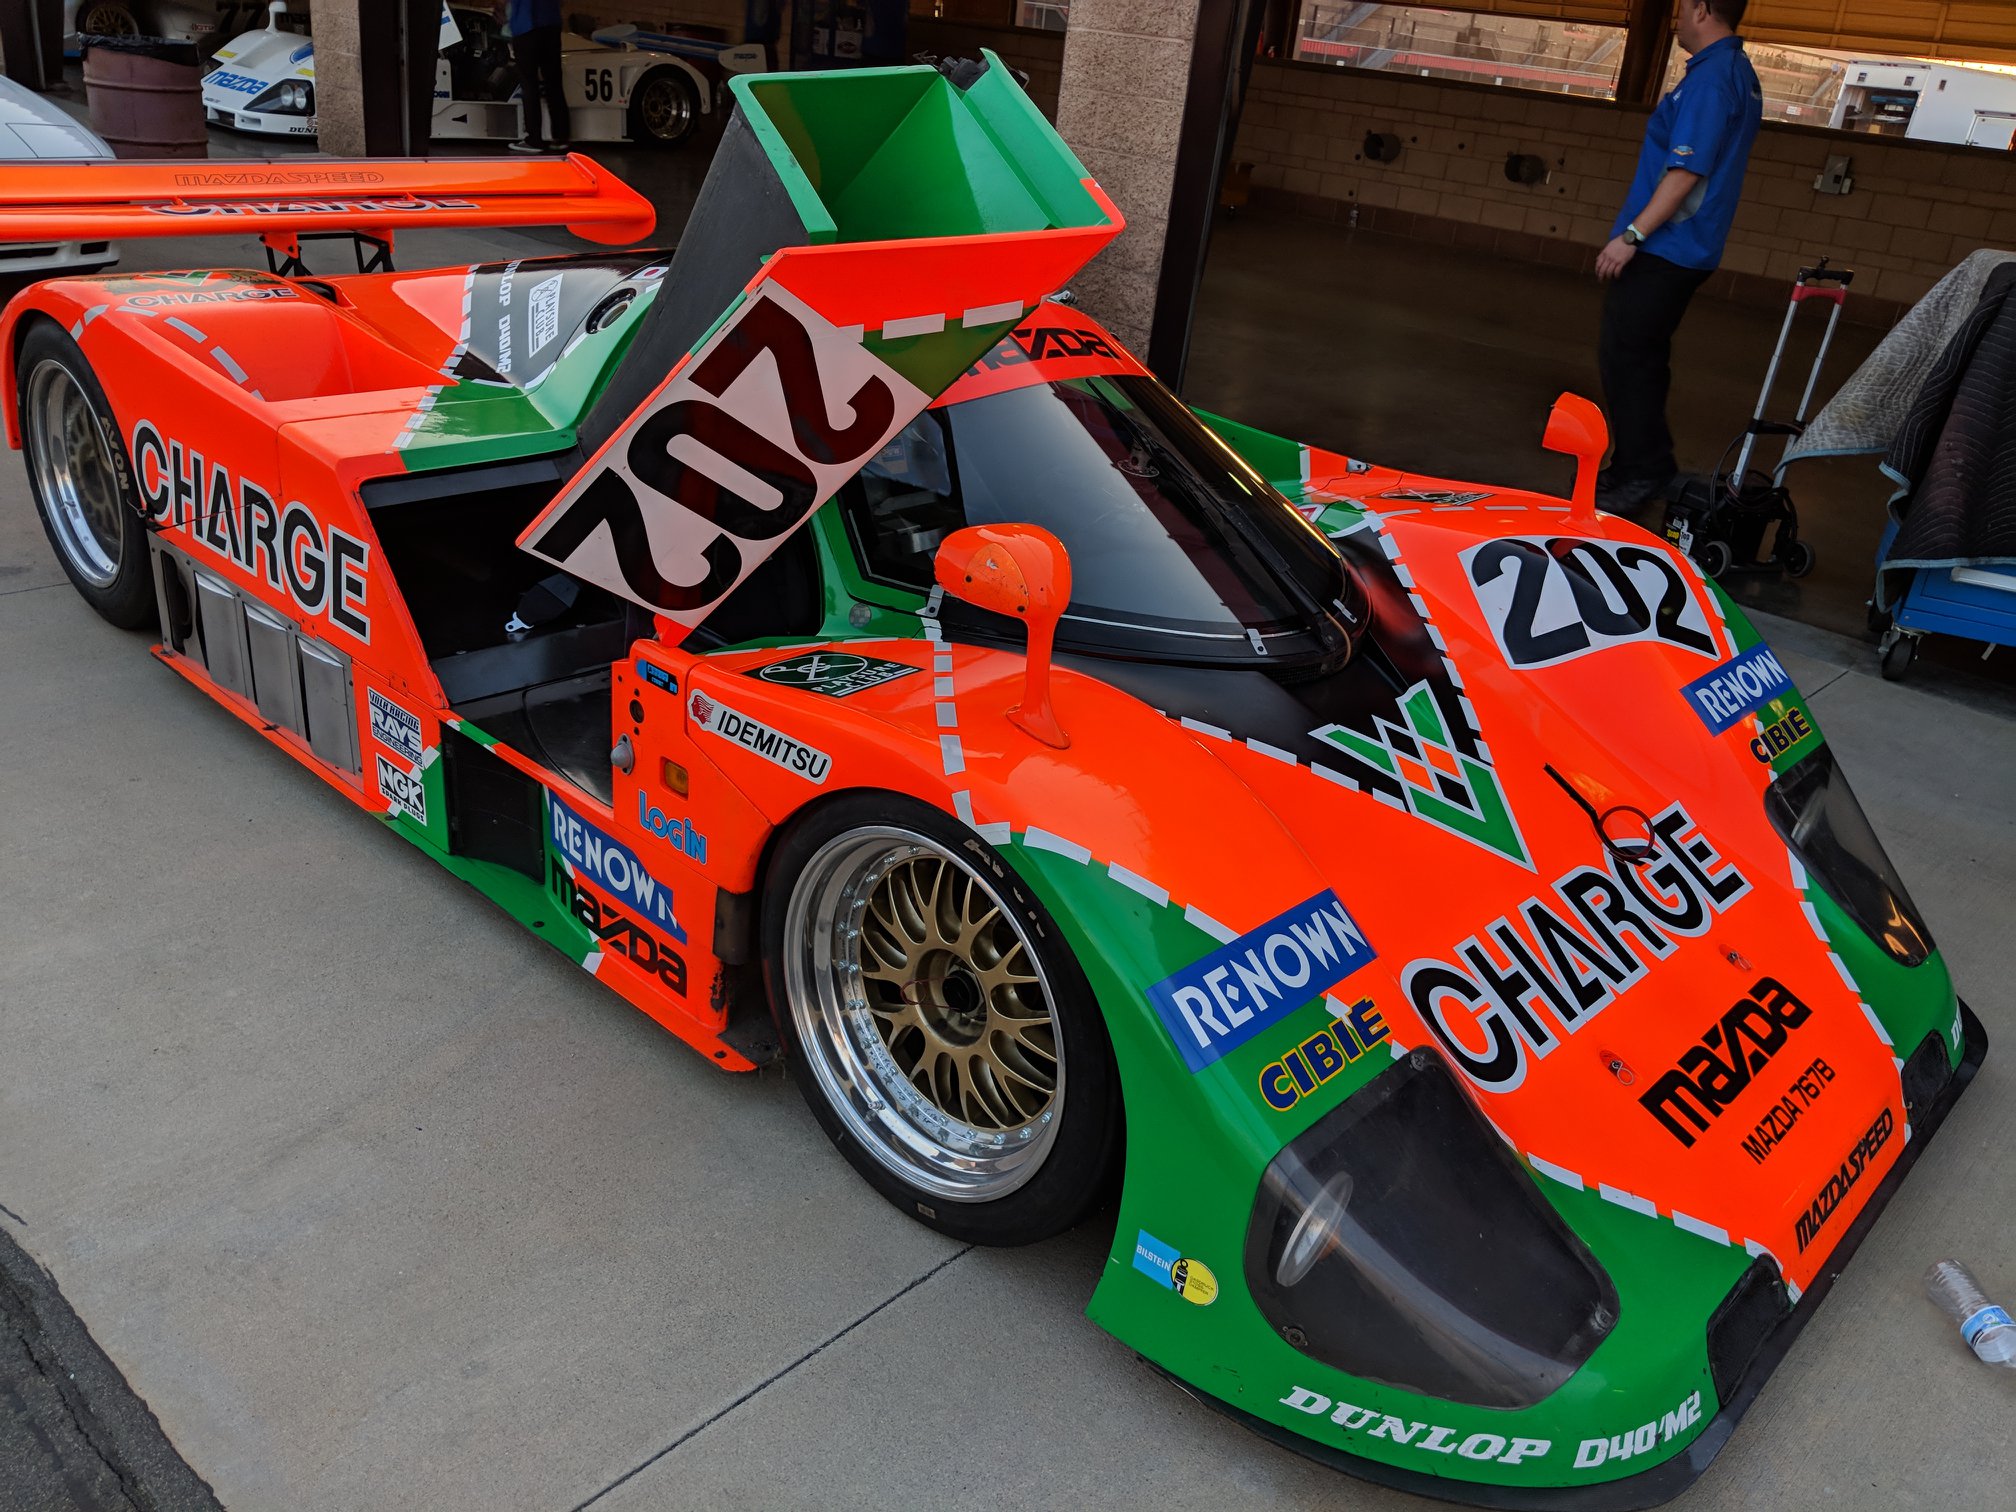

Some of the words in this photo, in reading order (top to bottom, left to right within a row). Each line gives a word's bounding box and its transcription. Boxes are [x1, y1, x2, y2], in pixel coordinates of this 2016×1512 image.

[204, 71, 270, 95] mazda
[585, 68, 613, 101] 56
[175, 171, 385, 187] MAZDASPEED
[126, 288, 300, 308] CHARGE
[101, 416, 130, 490] AVON
[533, 295, 896, 611] 202
[132, 418, 371, 646] CHARGE
[1471, 538, 1720, 665] 202
[811, 663, 901, 692] PLAYSURE
[845, 671, 894, 688] CLUB
[1694, 650, 1789, 724] RENOWN
[370, 705, 423, 754] RAYS
[372, 725, 423, 765] ENGINEERING
[717, 710, 828, 778] IDEMITSU
[379, 759, 424, 813] NGK
[381, 787, 402, 806] SPARK
[403, 803, 424, 822] PLUGS
[551, 854, 688, 1000] mazda
[1400, 799, 1754, 1094] CHARGE
[1171, 899, 1369, 1049] RENOWN
[1638, 976, 1814, 1149] mazda
[1740, 1095, 1804, 1165] MAZDA
[1788, 1057, 1836, 1108] 767B
[1794, 1106, 1895, 1256] MAZDASPEED
[1136, 1244, 1172, 1272] BILSTEIN
[1279, 1385, 1552, 1465] DUNLOP
